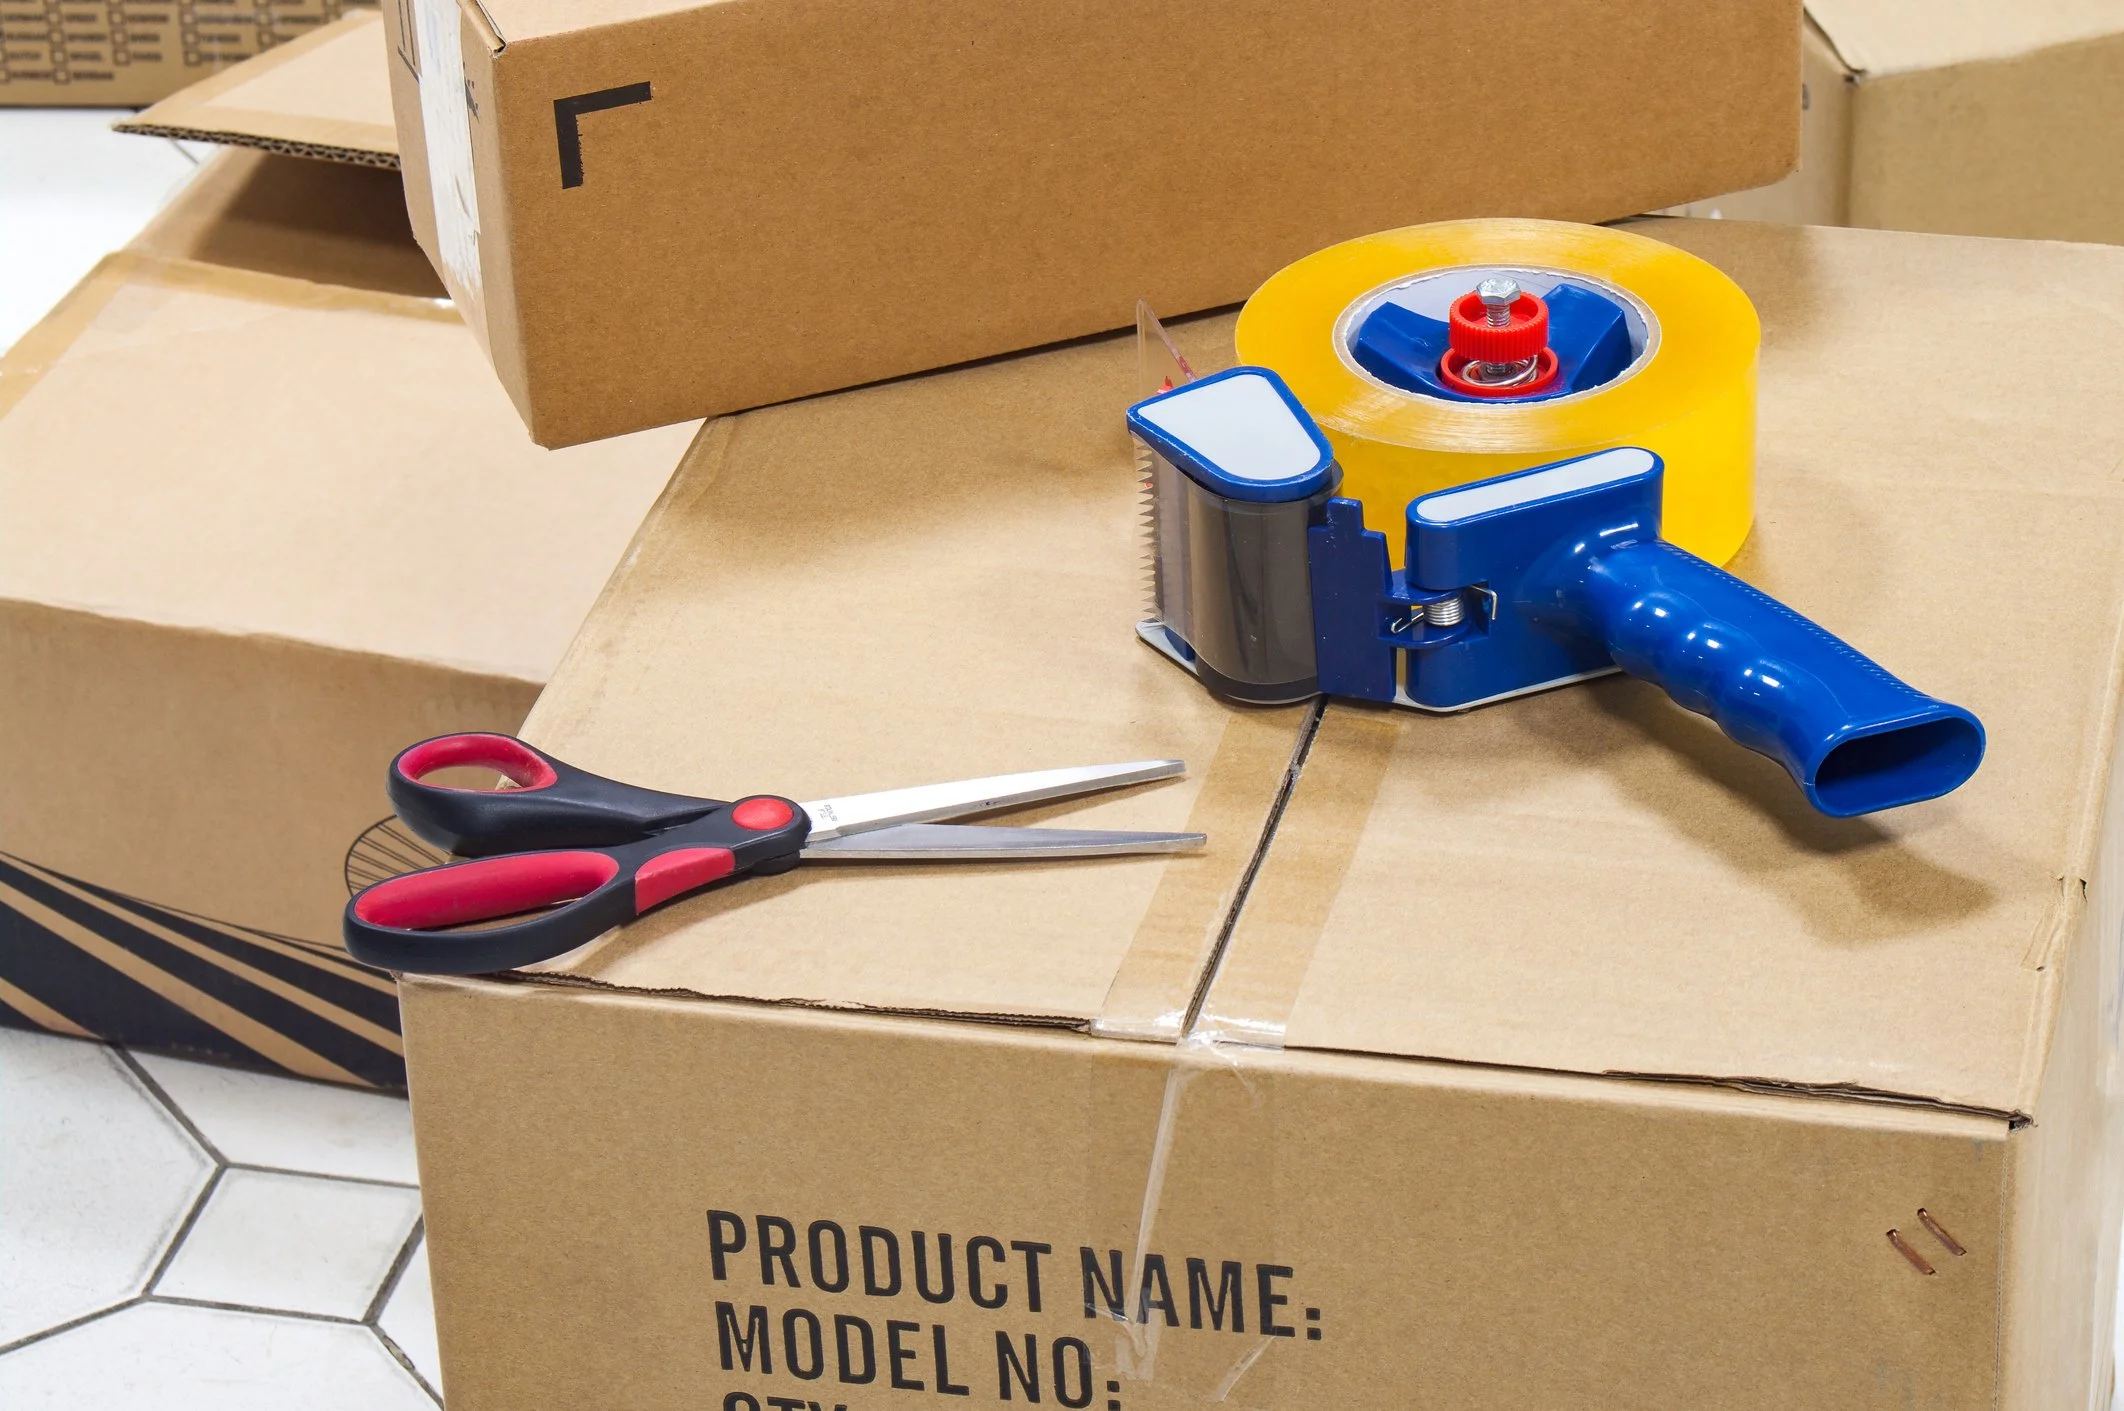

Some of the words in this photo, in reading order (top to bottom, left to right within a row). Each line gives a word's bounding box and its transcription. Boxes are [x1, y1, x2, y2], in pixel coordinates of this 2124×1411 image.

[706, 1209, 1052, 1313] PRODUCT
[1079, 1246, 1322, 1341] NAME:
[714, 1300, 970, 1396] MODEL
[995, 1330, 1122, 1411] NO:
